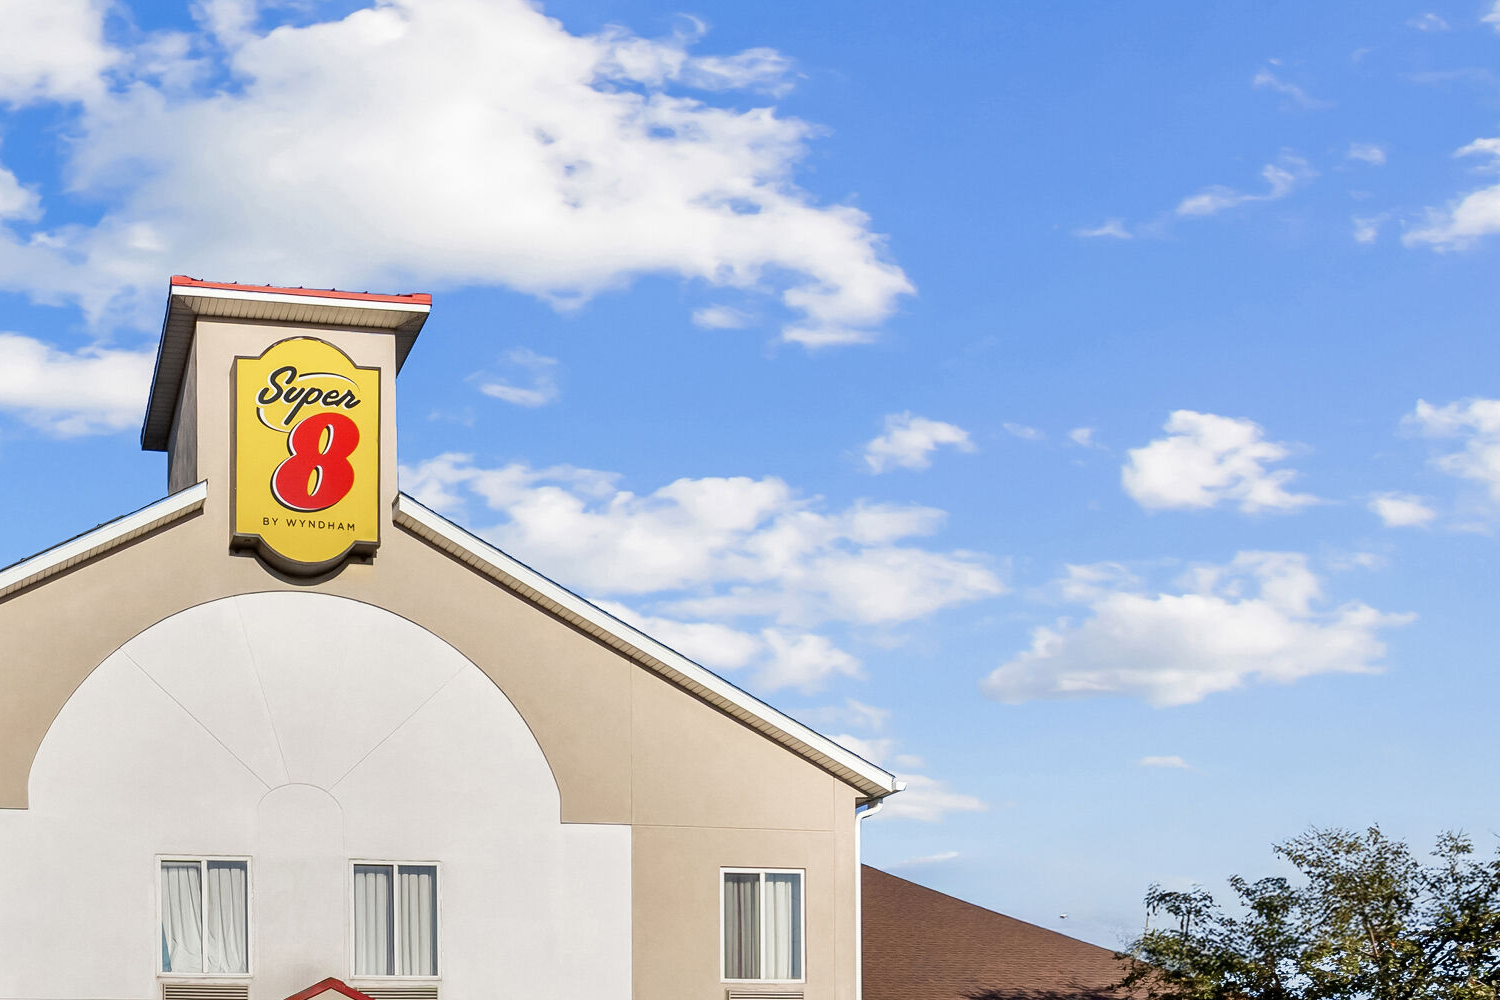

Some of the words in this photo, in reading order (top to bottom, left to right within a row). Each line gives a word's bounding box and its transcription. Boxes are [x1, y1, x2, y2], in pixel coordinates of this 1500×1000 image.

[257, 366, 361, 426] Super
[270, 412, 360, 513] 8
[262, 517, 279, 527] BY
[286, 518, 355, 531] WYNDHAM
